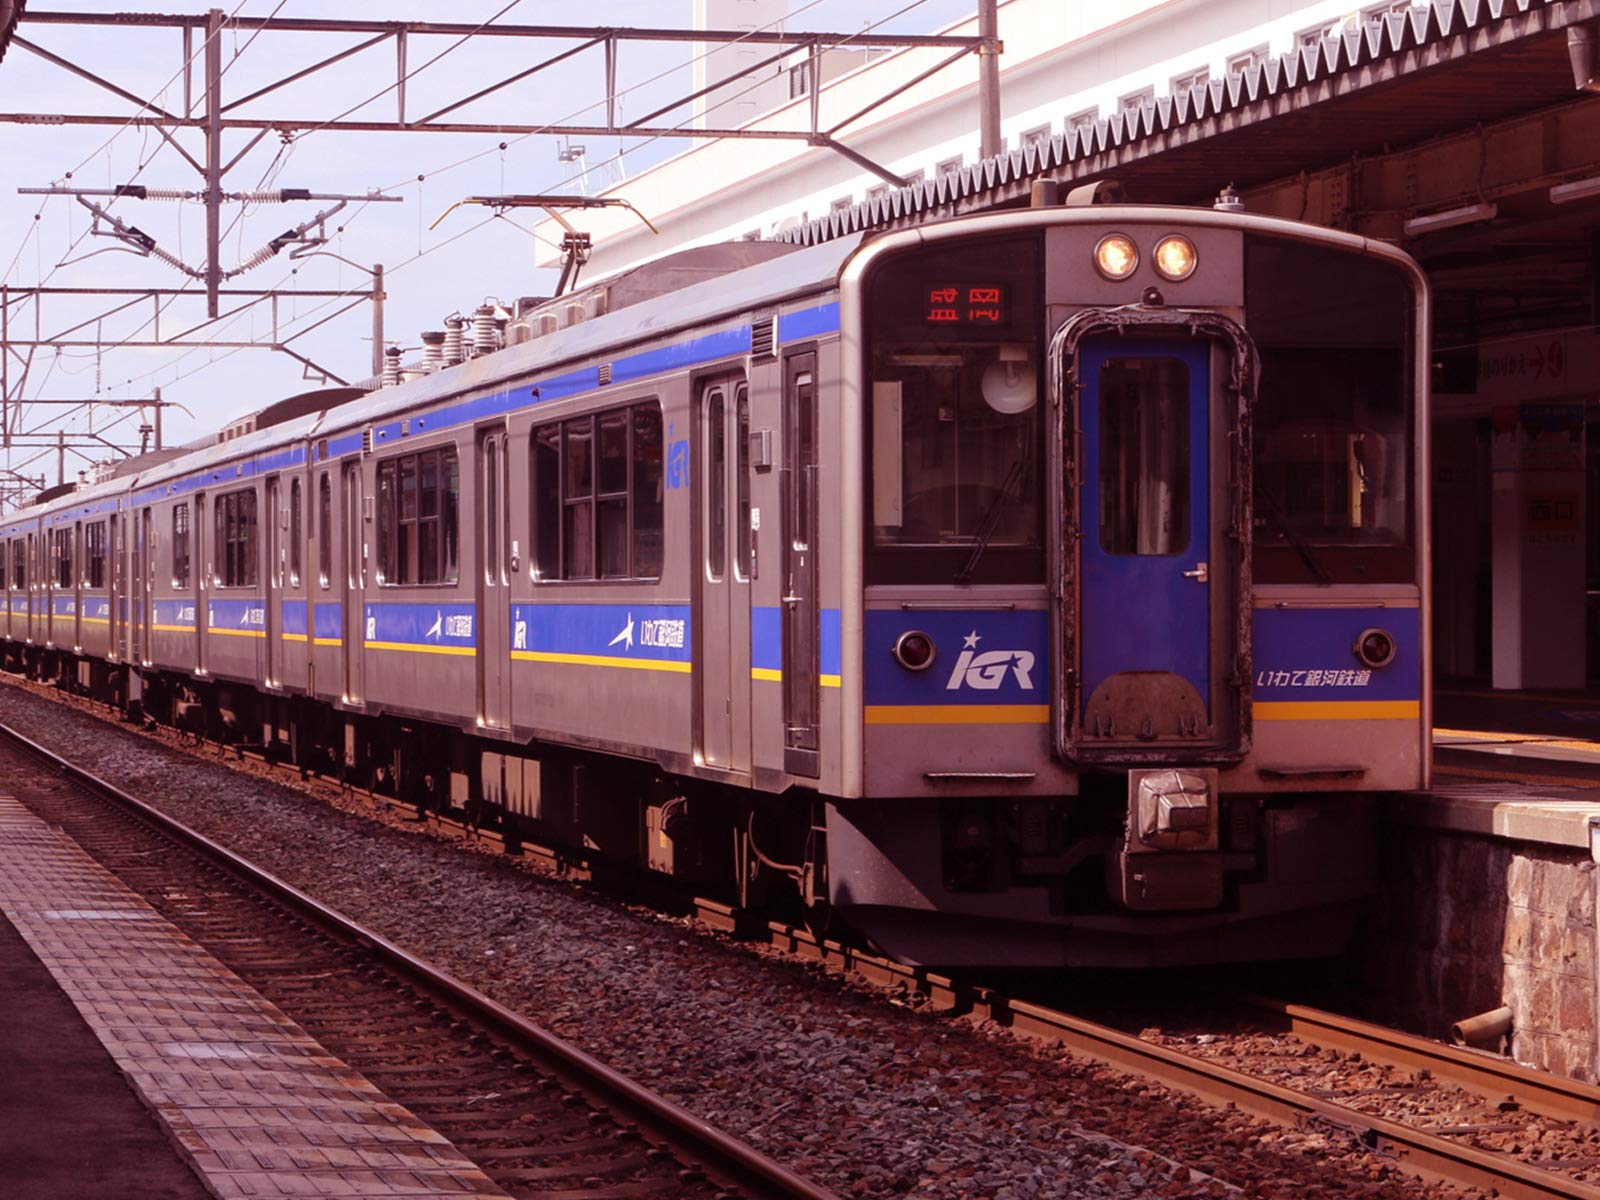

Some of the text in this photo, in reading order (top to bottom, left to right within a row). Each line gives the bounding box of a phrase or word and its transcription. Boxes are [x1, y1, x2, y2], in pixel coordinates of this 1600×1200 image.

[1256, 669, 1371, 687] いわて銀河鉄道
